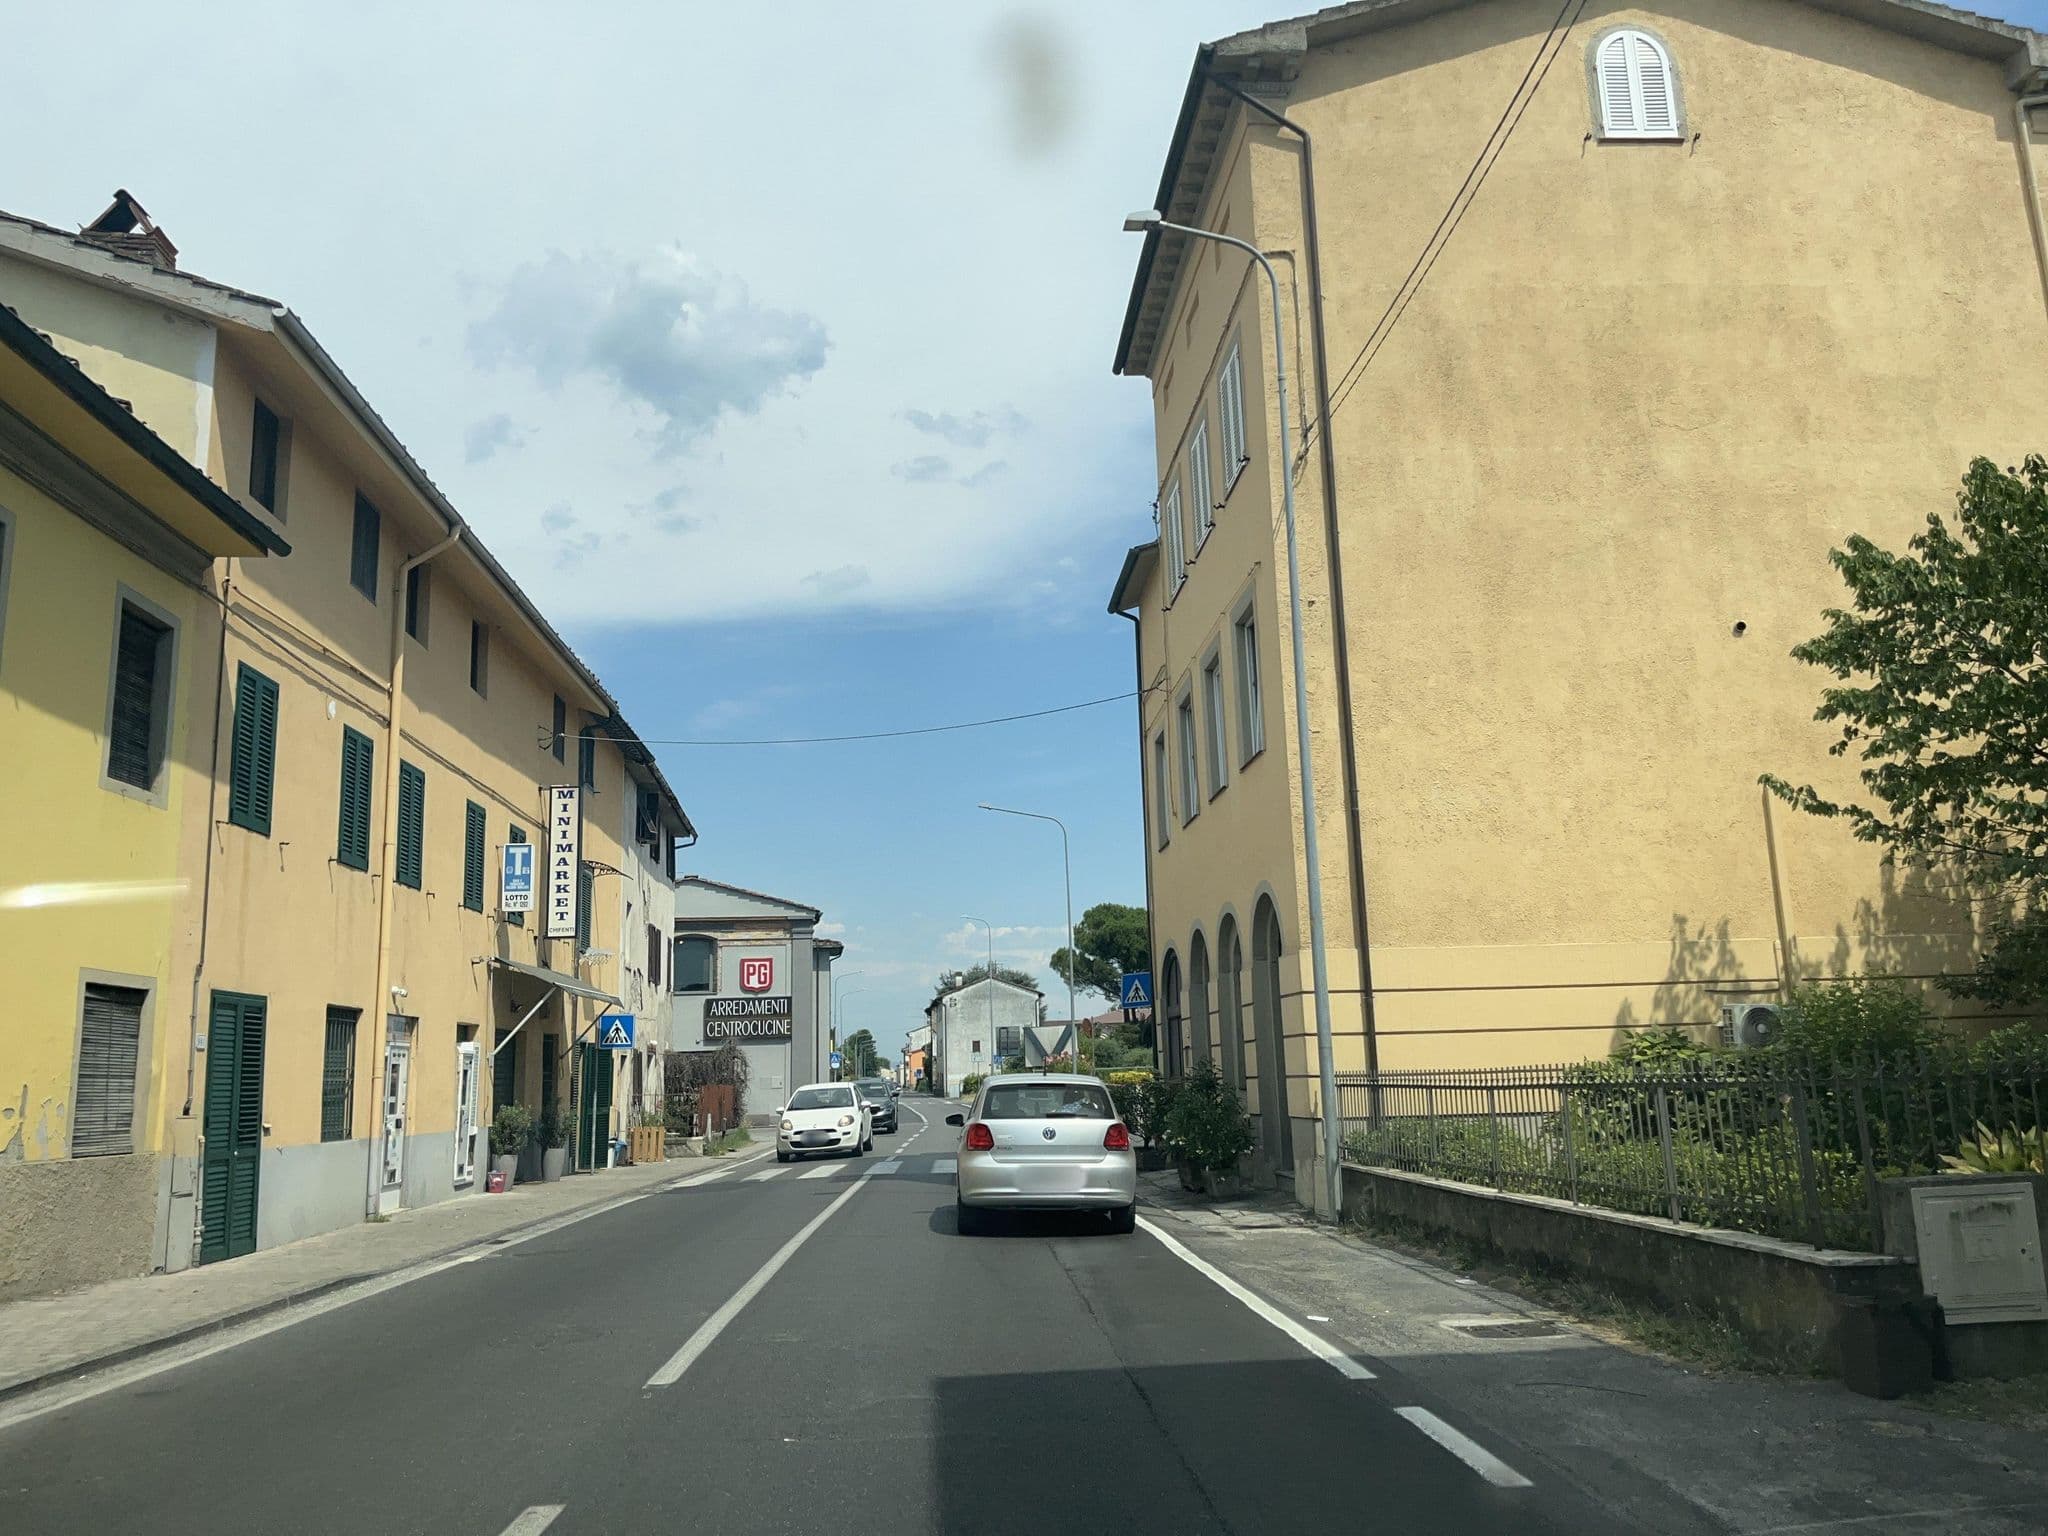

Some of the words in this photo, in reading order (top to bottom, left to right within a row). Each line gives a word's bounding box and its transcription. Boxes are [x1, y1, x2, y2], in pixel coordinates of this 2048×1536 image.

[554, 790, 575, 921] MINIMARKET
[746, 963, 768, 985] PG
[710, 999, 787, 1016] ARREDAMENTI
[706, 1019, 791, 1036] CENTROCUCINE
